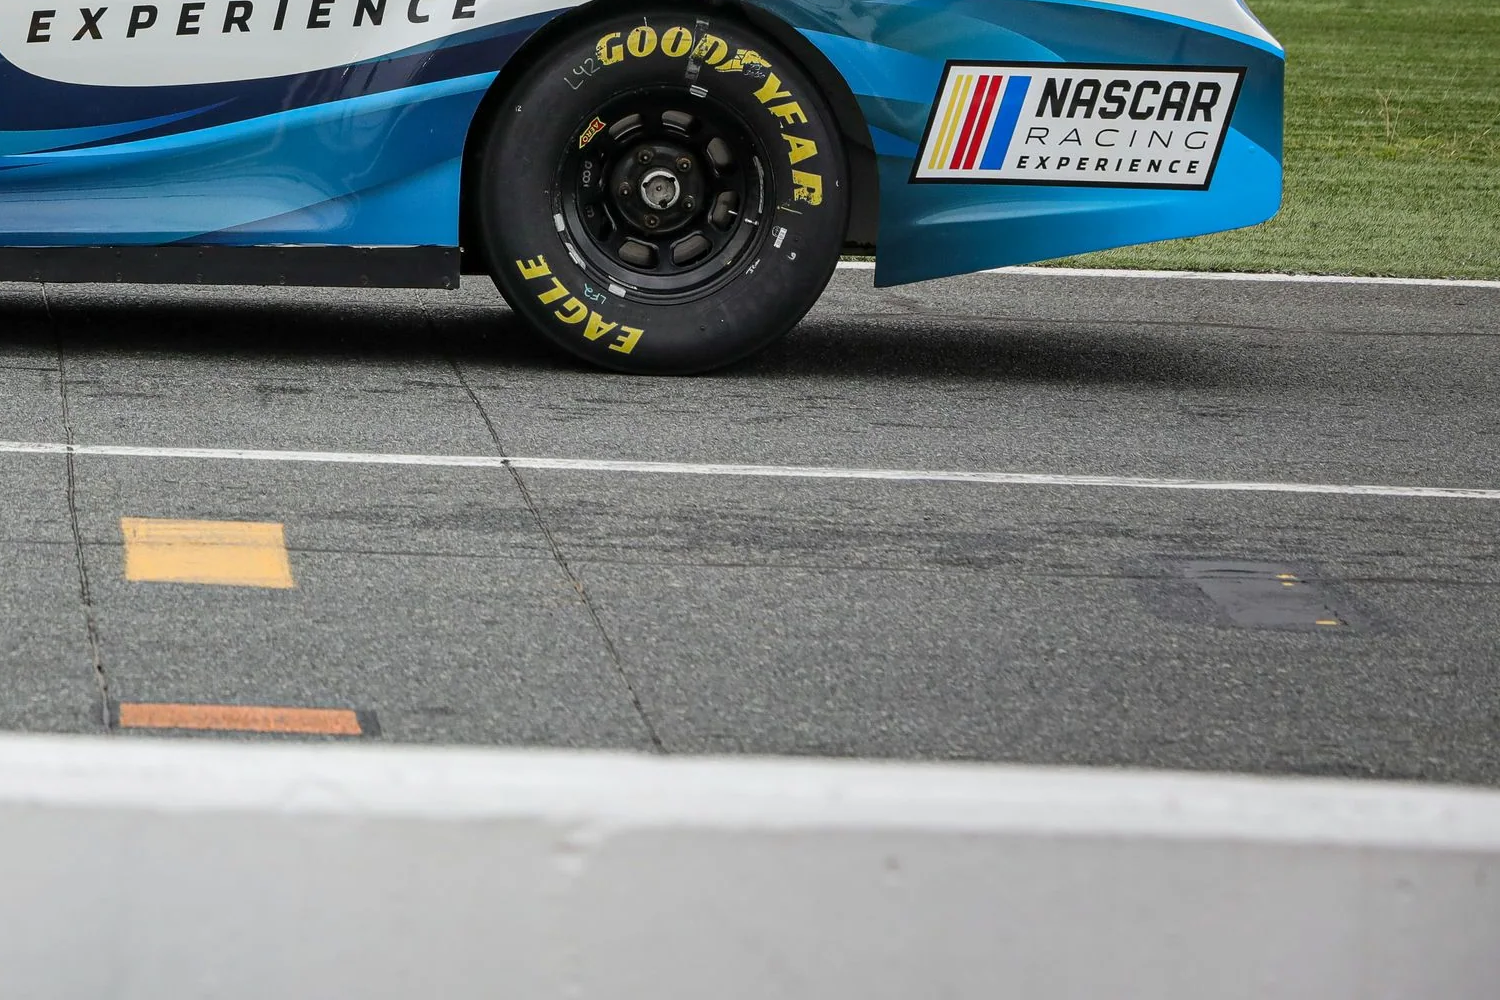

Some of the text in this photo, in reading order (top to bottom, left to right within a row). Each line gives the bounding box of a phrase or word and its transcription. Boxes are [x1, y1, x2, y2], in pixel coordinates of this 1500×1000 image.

[563, 57, 601, 90] L42
[1035, 77, 1222, 122] NASCAR
[595, 25, 823, 206] GOODYEAR
[582, 121, 599, 143] AERO
[1025, 126, 1209, 150] RACING
[1016, 155, 1200, 174] EXPERIENCE
[515, 254, 645, 355] EAGLE
[584, 283, 607, 305] LF2
